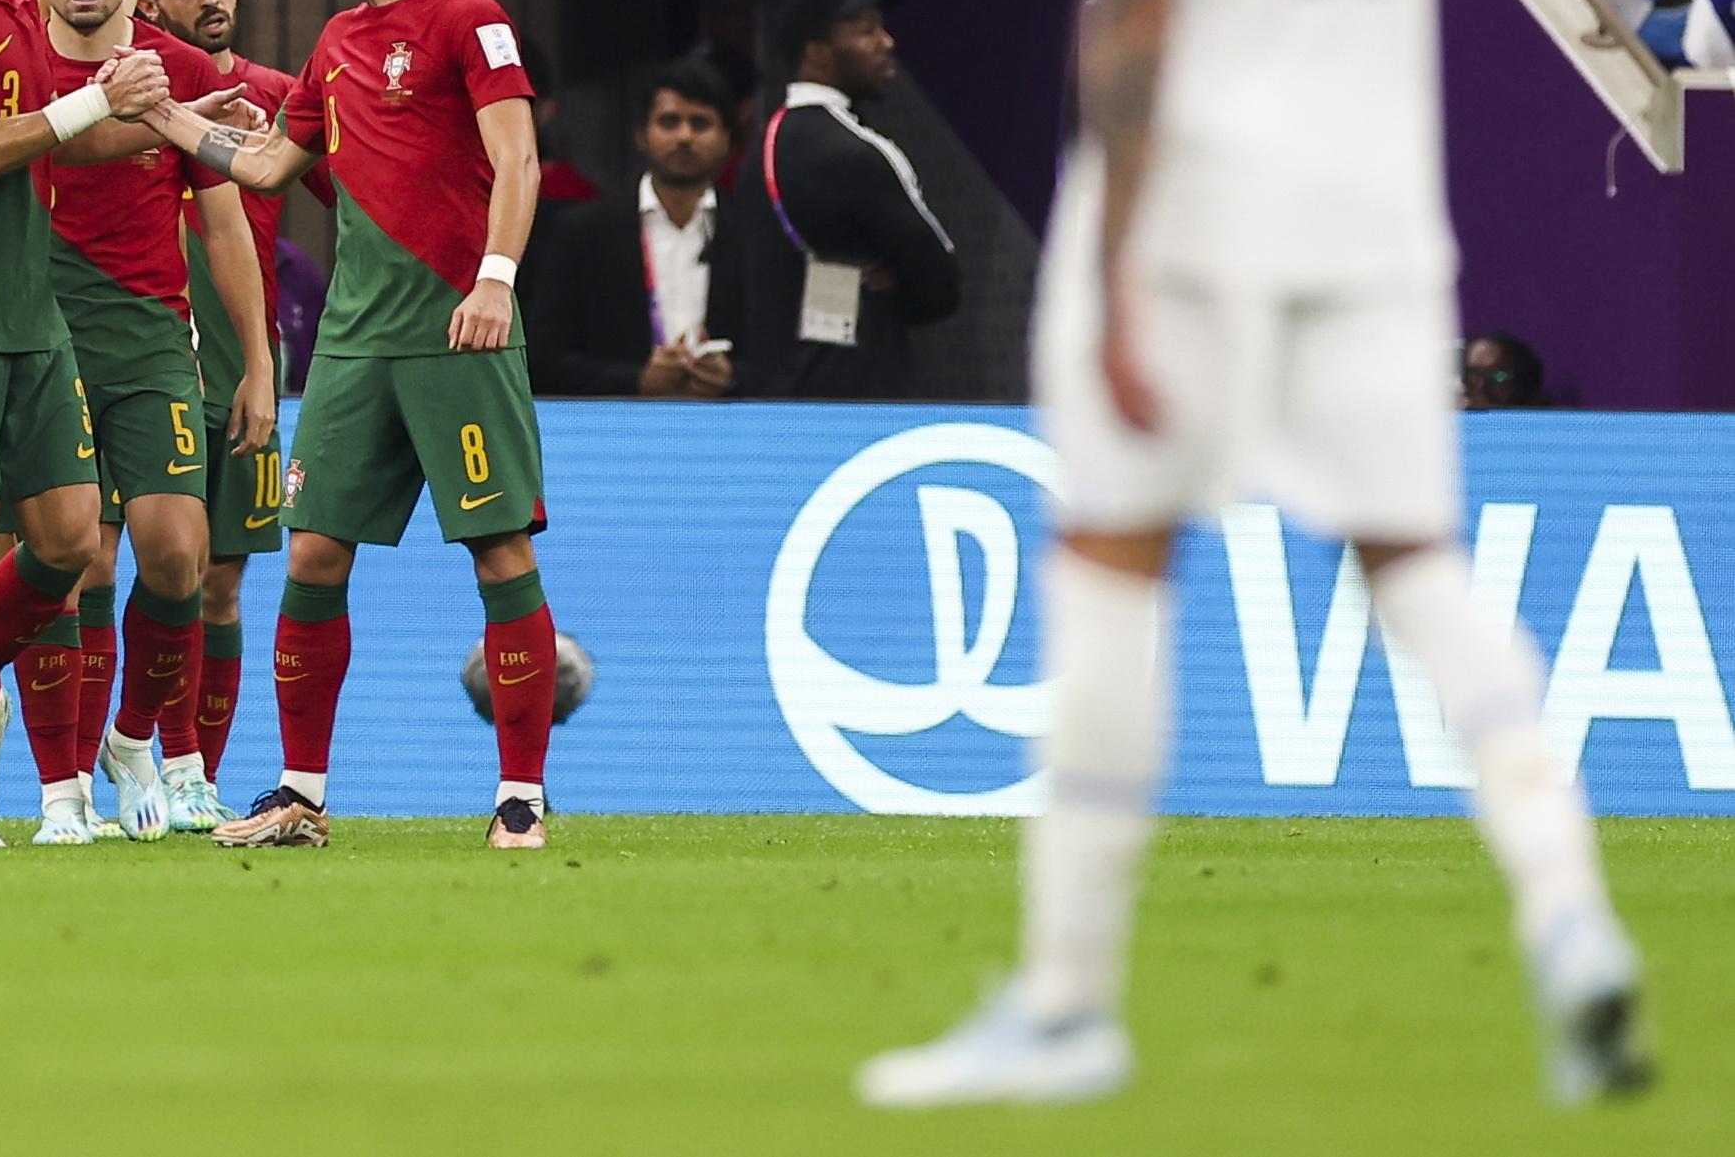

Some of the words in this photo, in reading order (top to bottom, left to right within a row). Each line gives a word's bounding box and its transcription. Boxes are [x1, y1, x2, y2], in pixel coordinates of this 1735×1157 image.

[170, 402, 196, 456] 5
[461, 424, 489, 483] 8
[255, 451, 281, 508] 10
